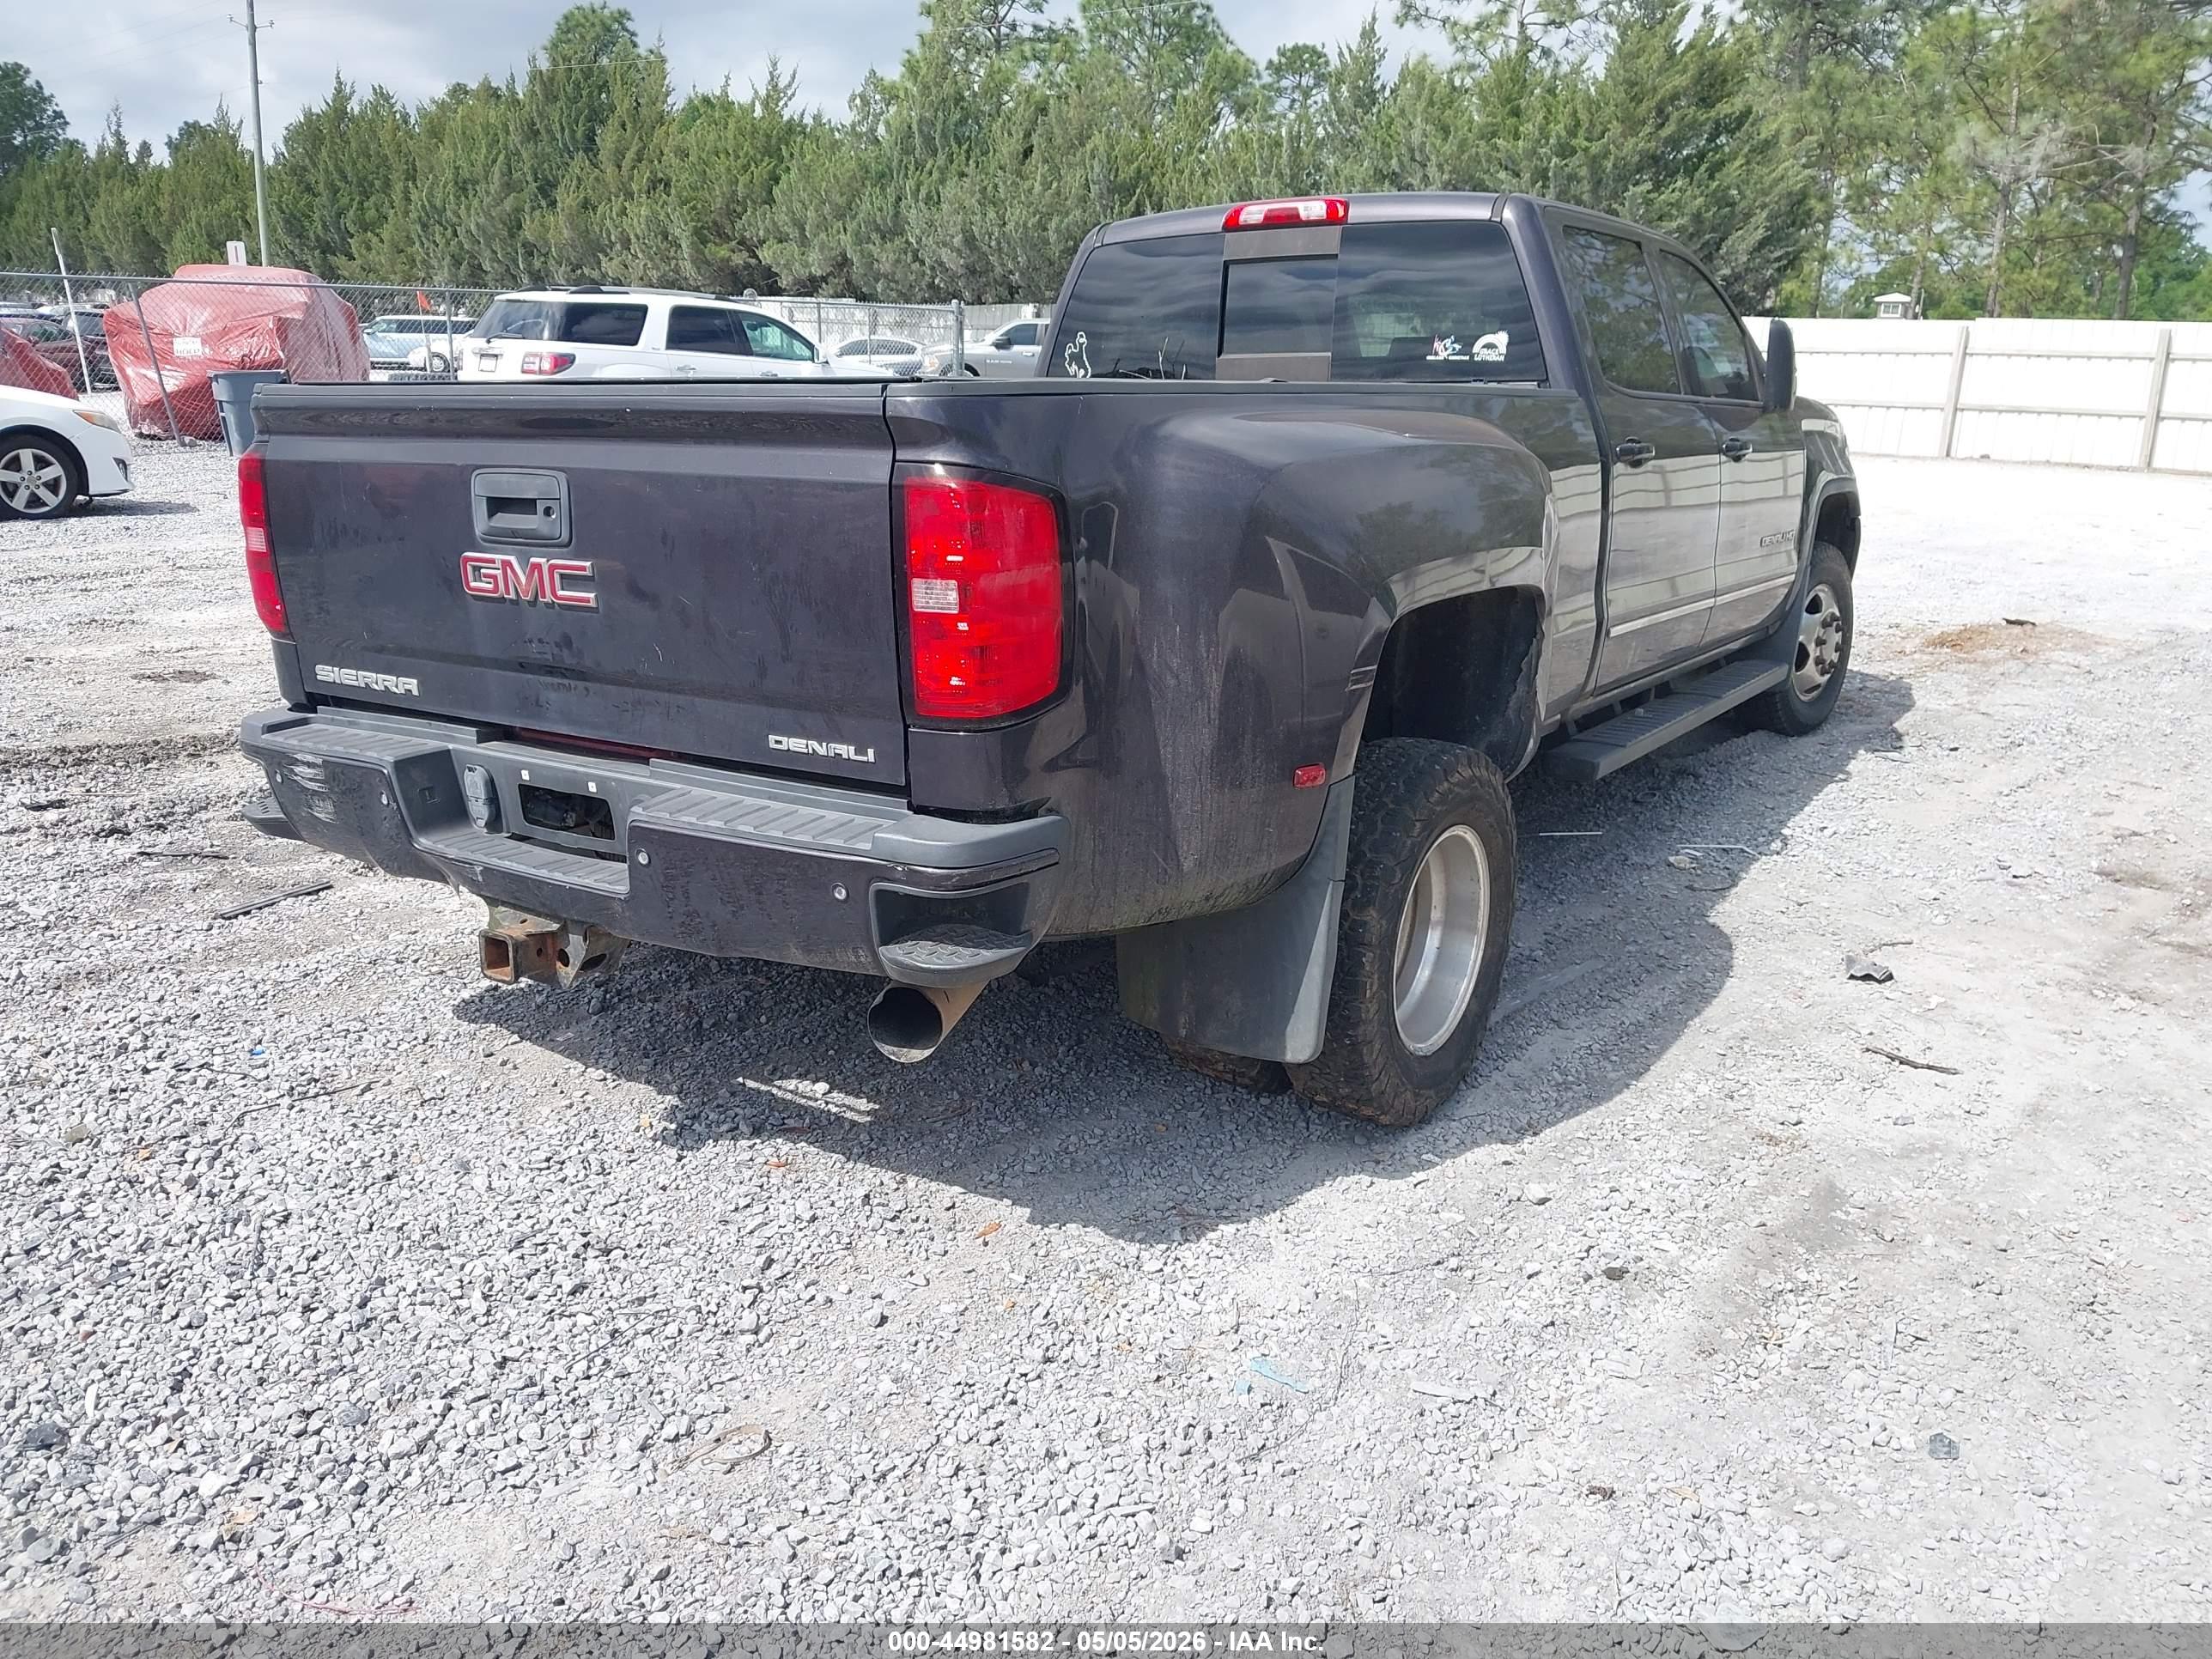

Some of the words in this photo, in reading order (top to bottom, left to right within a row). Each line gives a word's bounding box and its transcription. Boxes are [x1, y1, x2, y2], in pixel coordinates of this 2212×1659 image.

[460, 551, 599, 608] GMC
[314, 665, 420, 696] SIERRA
[768, 734, 876, 763] DENALI
